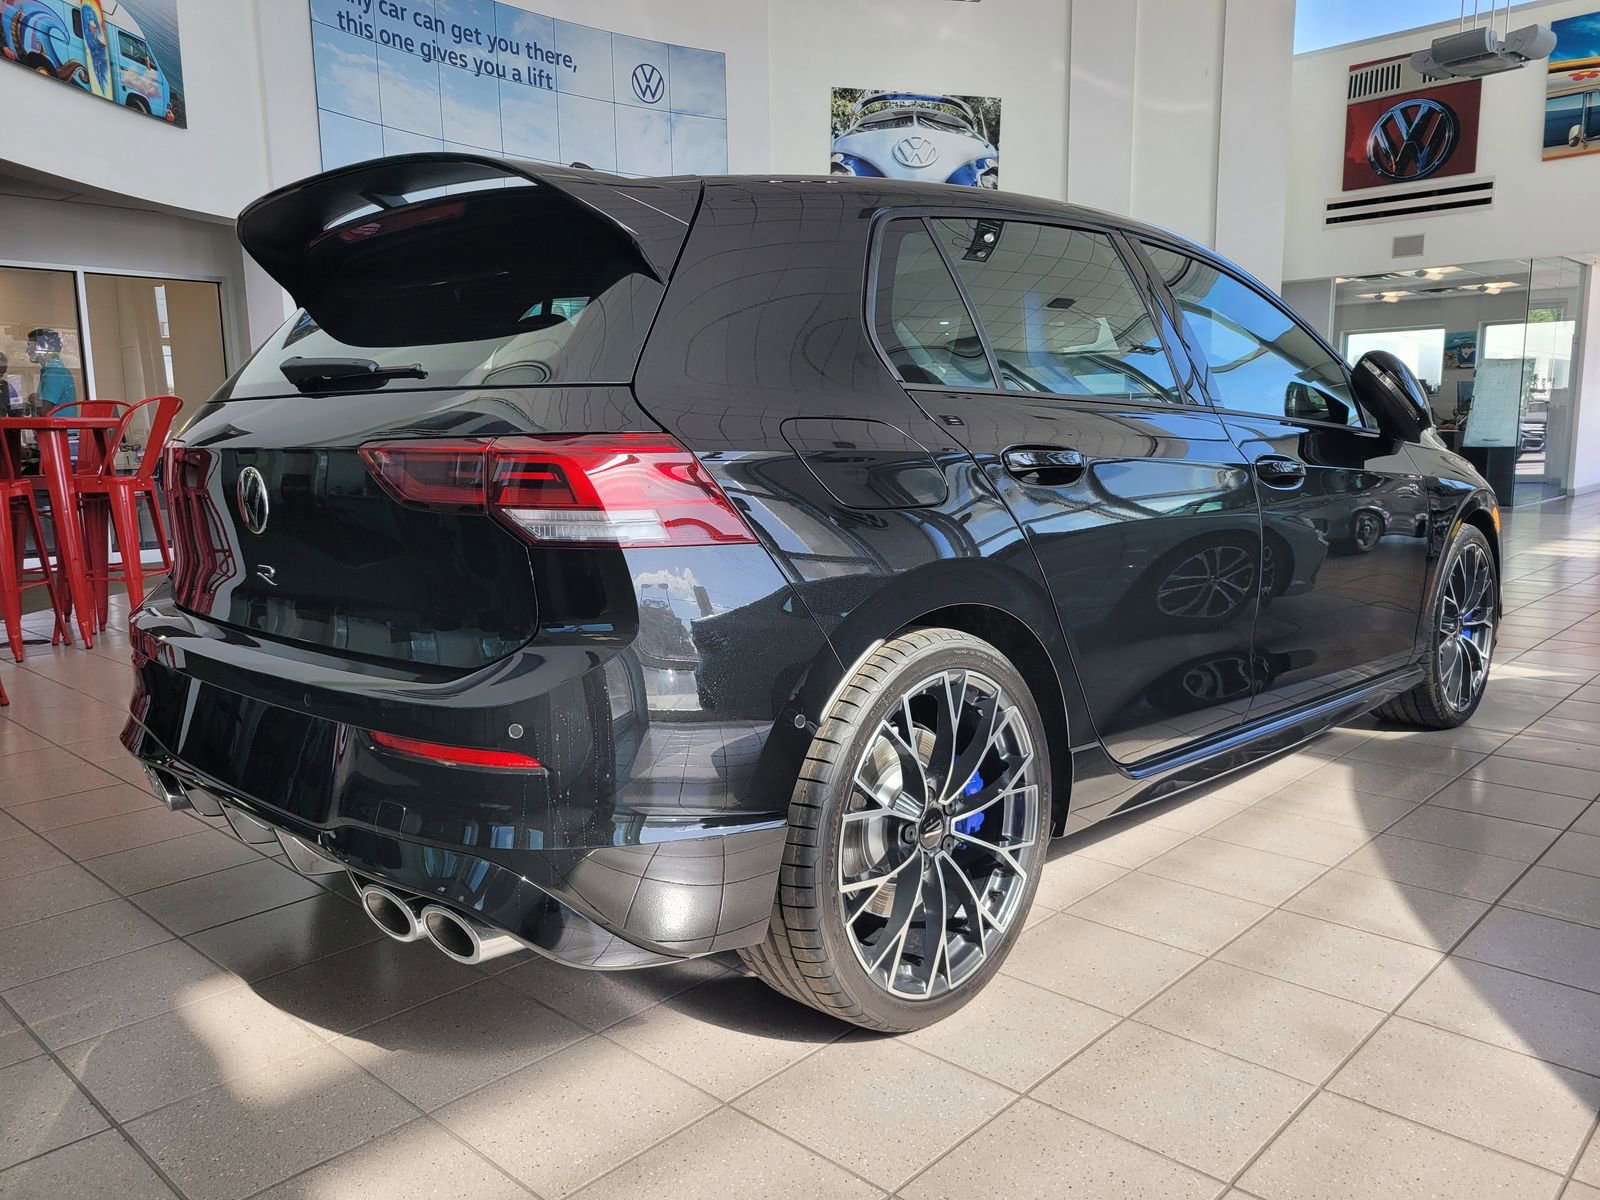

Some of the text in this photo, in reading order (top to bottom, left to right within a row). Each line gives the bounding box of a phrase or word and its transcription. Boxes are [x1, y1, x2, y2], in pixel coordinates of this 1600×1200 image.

[336, 10, 553, 90] this one gives you a lift
[378, 0, 407, 21] car
[413, 11, 445, 34] can
[451, 23, 482, 46] get
[487, 34, 520, 56] you
[525, 41, 577, 73] there,
